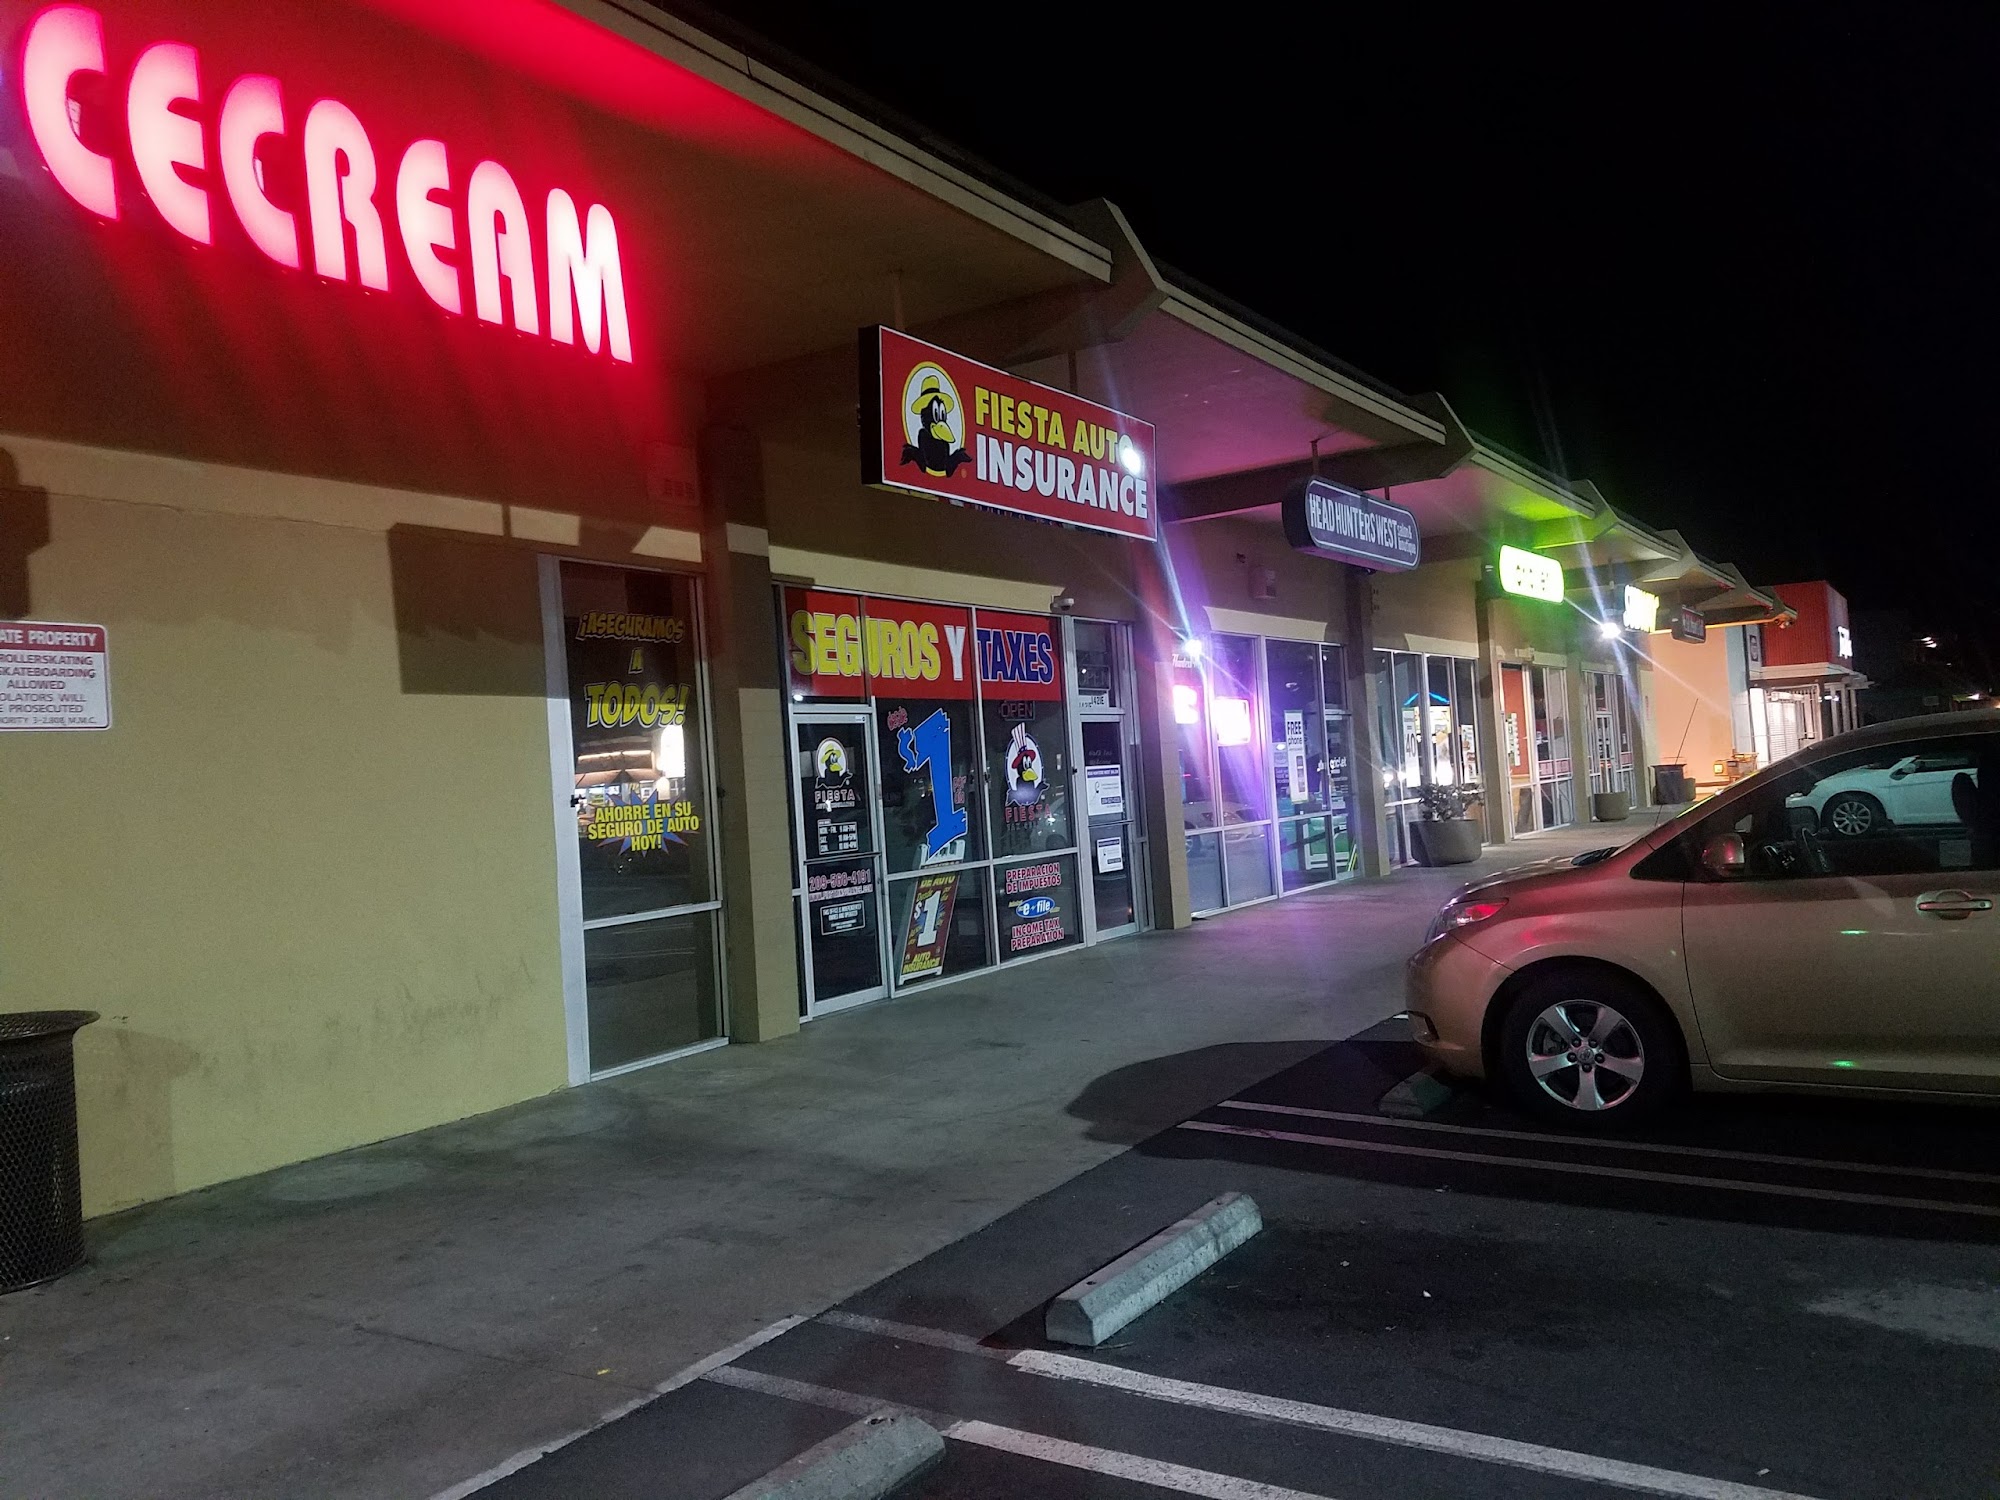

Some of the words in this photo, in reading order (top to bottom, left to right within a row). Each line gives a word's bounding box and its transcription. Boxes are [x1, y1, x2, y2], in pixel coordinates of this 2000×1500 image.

[975, 386, 1067, 450] FIESTA
[1072, 418, 1138, 471] AUTO
[976, 432, 1148, 519] INSURANCE
[1309, 493, 1335, 532] HEAD
[1335, 502, 1376, 543] HUNTERS
[1376, 514, 1398, 549] WEST
[28, 630, 97, 646] PROPERTY
[791, 610, 941, 681] SEGUROS
[944, 625, 966, 681] Y
[977, 627, 1055, 684] TAXES
[628, 647, 643, 673] A
[7, 680, 66, 690] ALLOWED
[58, 694, 87, 702] WILL
[584, 681, 691, 728] TODOS!
[9, 704, 84, 713] PROSECUTED
[1001, 702, 1033, 719] OPEN
[1287, 721, 1302, 735] FREE
[815, 789, 855, 803] FIESTA
[595, 804, 650, 823] AHORRE
[654, 803, 671, 818] EN
[674, 801, 692, 816] SU
[1005, 804, 1052, 823] FIESTA
[587, 820, 643, 840] SEGURO
[647, 819, 664, 834] DE
[667, 816, 700, 832] AUTO
[631, 834, 662, 851] HOY!
[1006, 862, 1060, 882] PREPARACION
[1006, 882, 1018, 894] DE
[1019, 874, 1061, 892] IMPUESTOS
[1012, 920, 1043, 938] INCOME
[1044, 917, 1060, 930] TAX
[1011, 928, 1065, 951] PREPARATION
[902, 957, 941, 974] INSURANCE
[913, 951, 931, 963] AUTO
